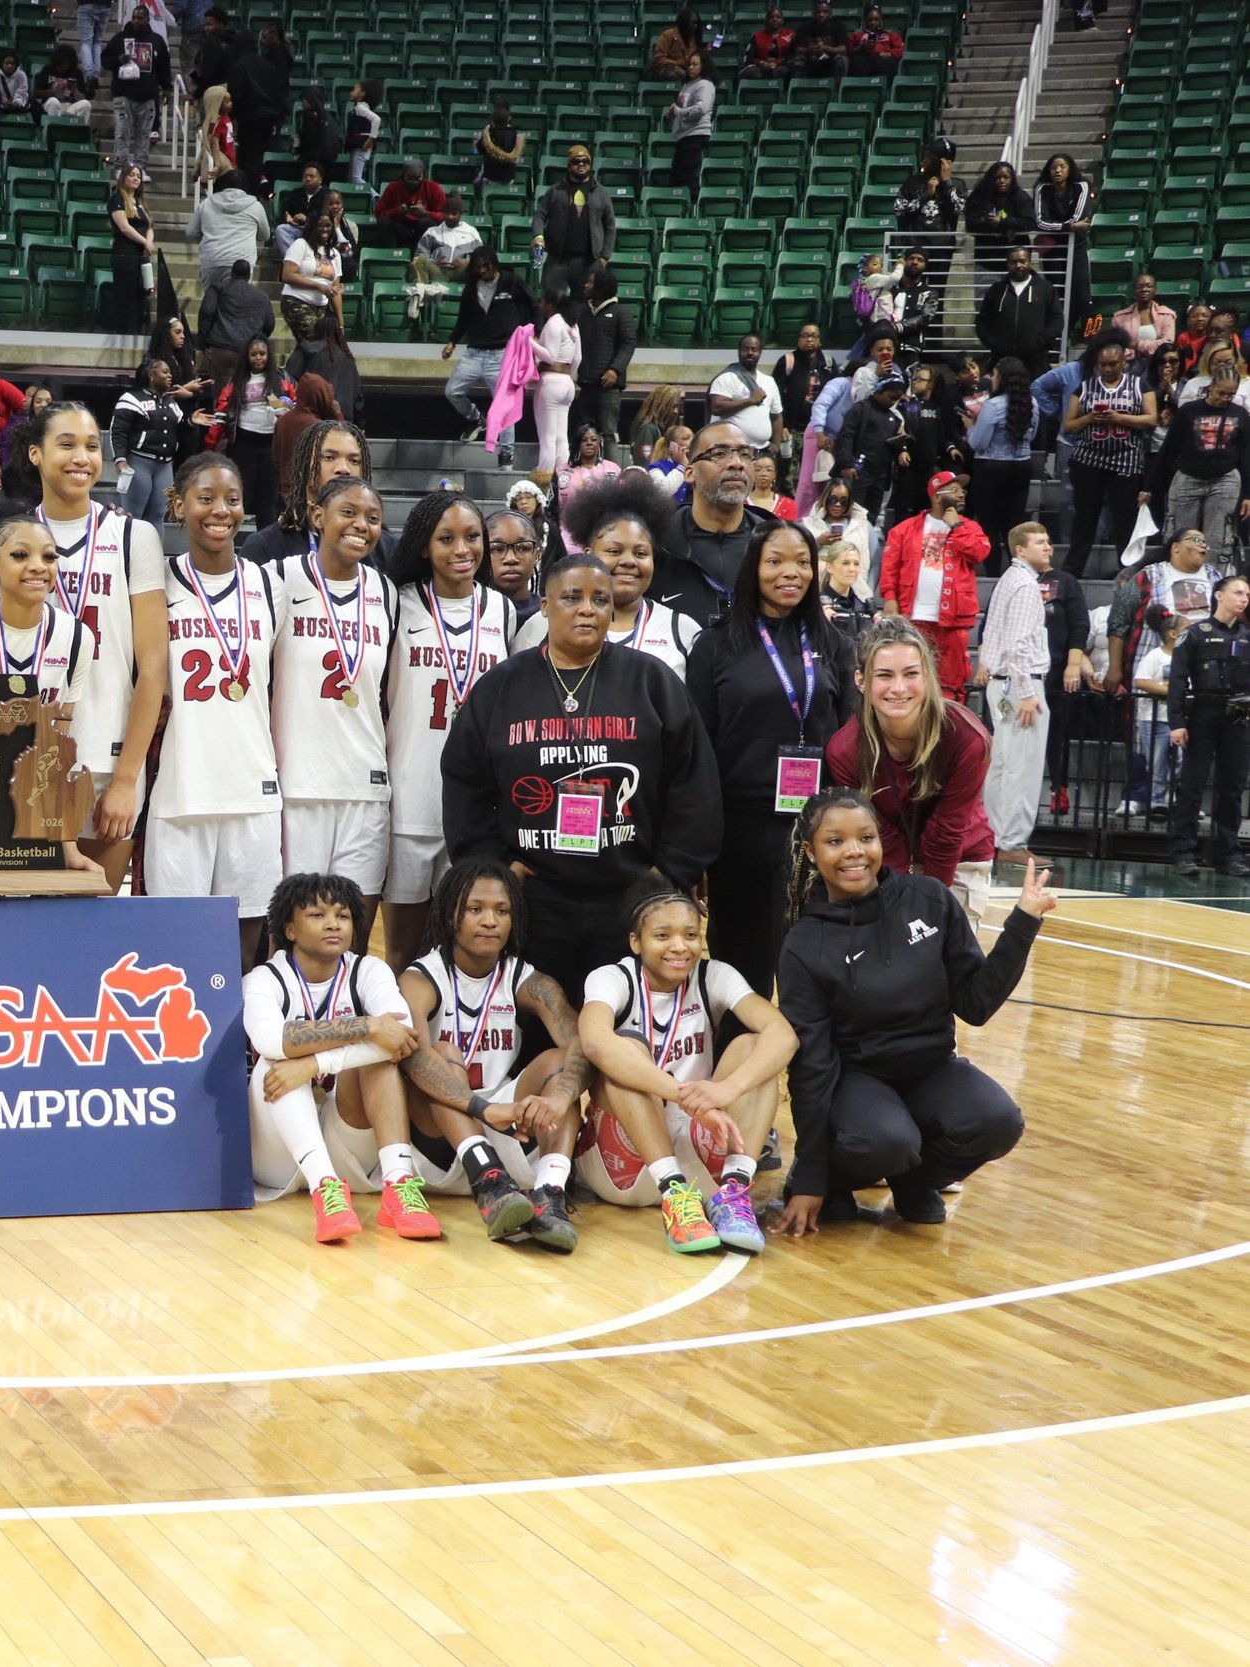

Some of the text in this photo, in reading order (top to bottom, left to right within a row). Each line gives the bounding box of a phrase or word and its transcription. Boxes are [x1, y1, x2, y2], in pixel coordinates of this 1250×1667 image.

[181, 649, 251, 702] 23
[320, 650, 353, 701] 2
[430, 678, 452, 730] 1
[524, 719, 539, 743] W.
[605, 716, 637, 743] GIRLZ
[539, 745, 608, 767] APPLYING
[39, 819, 64, 828] 2026
[518, 828, 540, 850] ONE
[541, 829, 557, 849] TE
[908, 918, 931, 938] M
